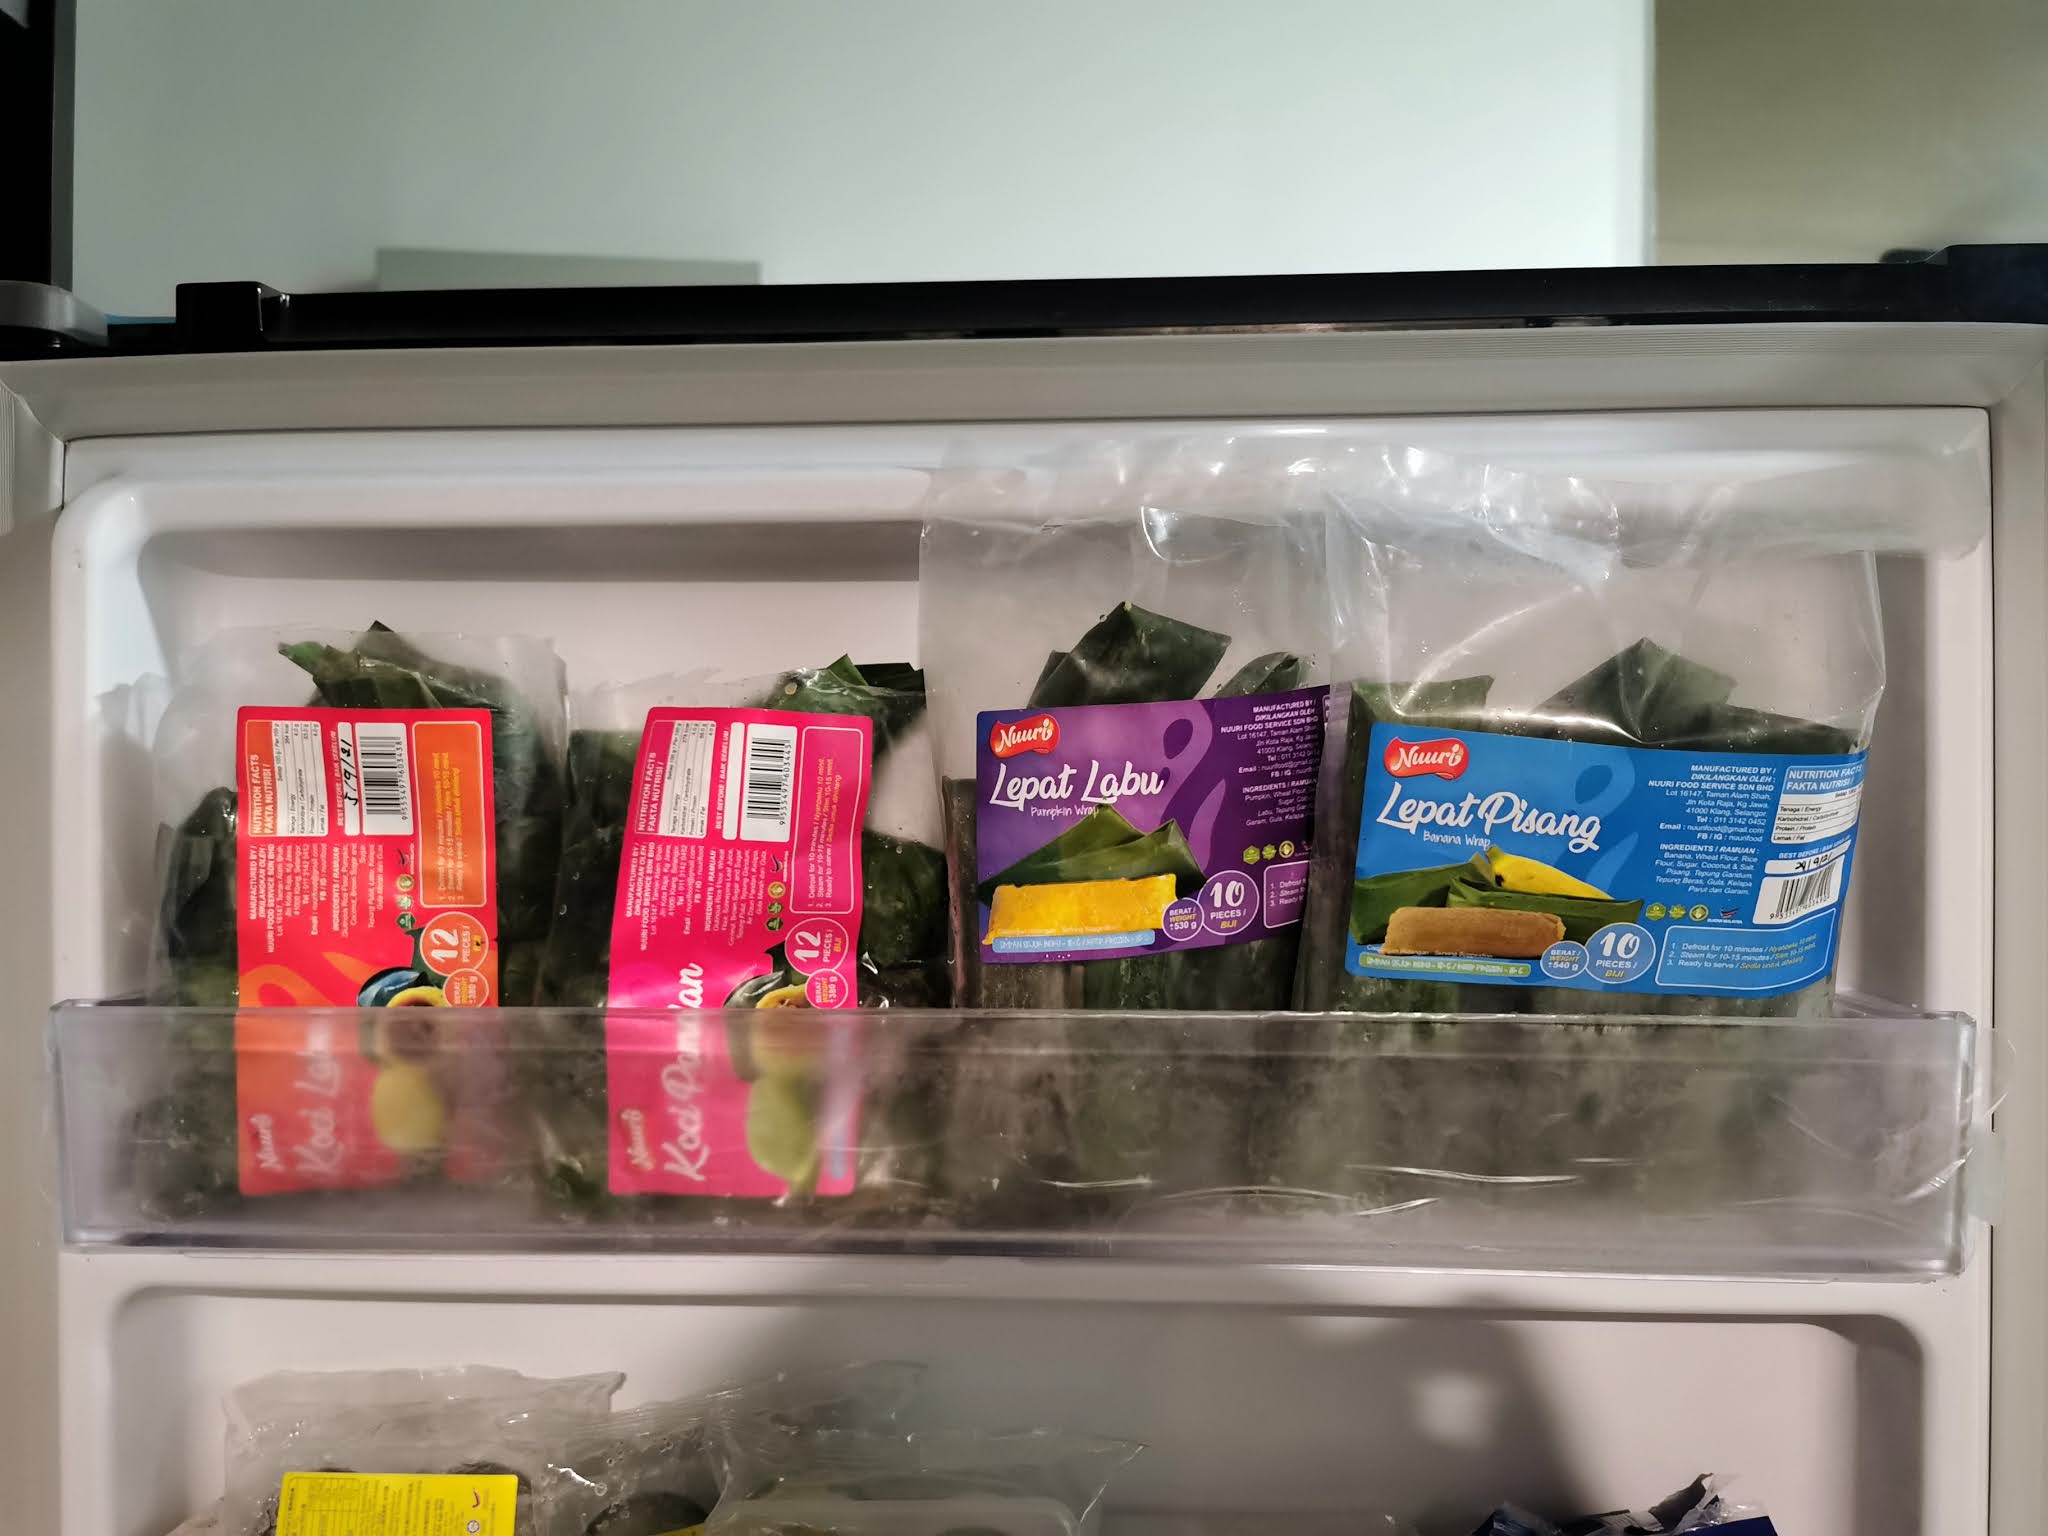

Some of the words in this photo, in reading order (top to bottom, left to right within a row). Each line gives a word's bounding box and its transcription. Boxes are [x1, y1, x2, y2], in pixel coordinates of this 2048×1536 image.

[996, 718, 1053, 752] Nuuri
[250, 755, 260, 783] FACTS
[1392, 744, 1464, 771] Nuuri
[1238, 766, 1257, 774] Email
[1691, 765, 1759, 774] MANUFACTURED
[1691, 774, 1748, 782] DIKILANGKAN
[1788, 769, 1839, 779] NUTRITION
[1840, 764, 1863, 778] FACTS
[263, 769, 273, 803] NUTRISI
[638, 784, 650, 831] NUTRITION
[645, 752, 656, 781] FACTS
[651, 766, 663, 801] NUTRISI
[989, 762, 1077, 811] Lepat
[1080, 760, 1164, 804] Labu
[1676, 781, 1699, 789] FOOD
[1701, 782, 1736, 790] SERVICE
[1786, 781, 1818, 790] FAKTA
[1820, 778, 1850, 790] NUTRISI
[252, 786, 262, 833] NUTRITION
[264, 804, 273, 833] FAKTA
[648, 803, 658, 831] FAKTA
[1031, 805, 1072, 820] Pumpkin
[1076, 803, 1099, 819] Wrap
[1376, 782, 1481, 835] Lepat
[1478, 792, 1602, 853] Pisang
[1423, 830, 1461, 845] Banana
[1464, 833, 1491, 850] Wrap
[1695, 870, 1720, 879] Tepung
[1727, 880, 1752, 888] Kelapa
[1210, 881, 1245, 908] 10
[1688, 886, 1707, 894] Parut
[1169, 908, 1191, 916] BERAT
[1210, 910, 1241, 920] PIECES
[1220, 921, 1238, 929] BIJI
[430, 928, 459, 963] 12
[461, 930, 471, 963] PIECES
[795, 930, 821, 963] 12
[822, 933, 833, 963] PIECES
[1600, 932, 1640, 959] 10
[1680, 951, 1705, 959] Steam
[1596, 960, 1632, 968] PIECES
[1678, 959, 1702, 968] Ready
